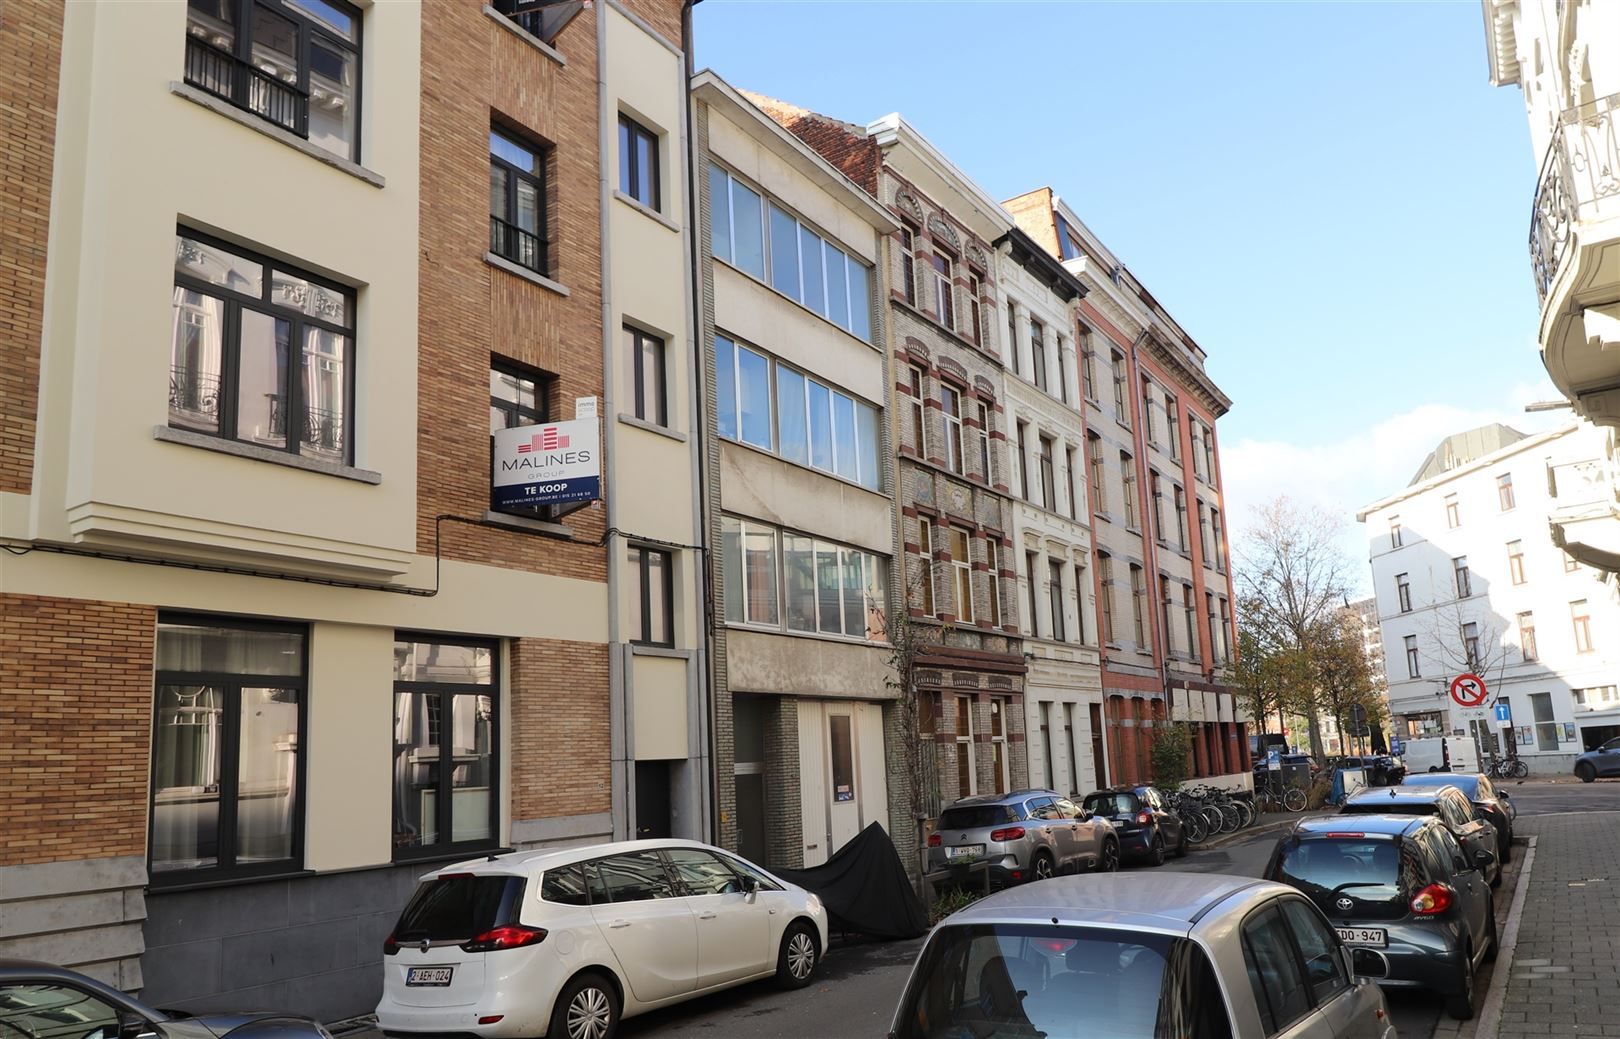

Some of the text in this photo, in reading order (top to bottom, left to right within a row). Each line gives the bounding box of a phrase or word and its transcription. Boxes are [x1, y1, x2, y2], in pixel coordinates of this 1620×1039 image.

[502, 450, 591, 471] MALINES
[527, 470, 565, 480] GROUP
[524, 483, 568, 495] TE KOOP
[411, 970, 450, 981] 2-AEH-024
